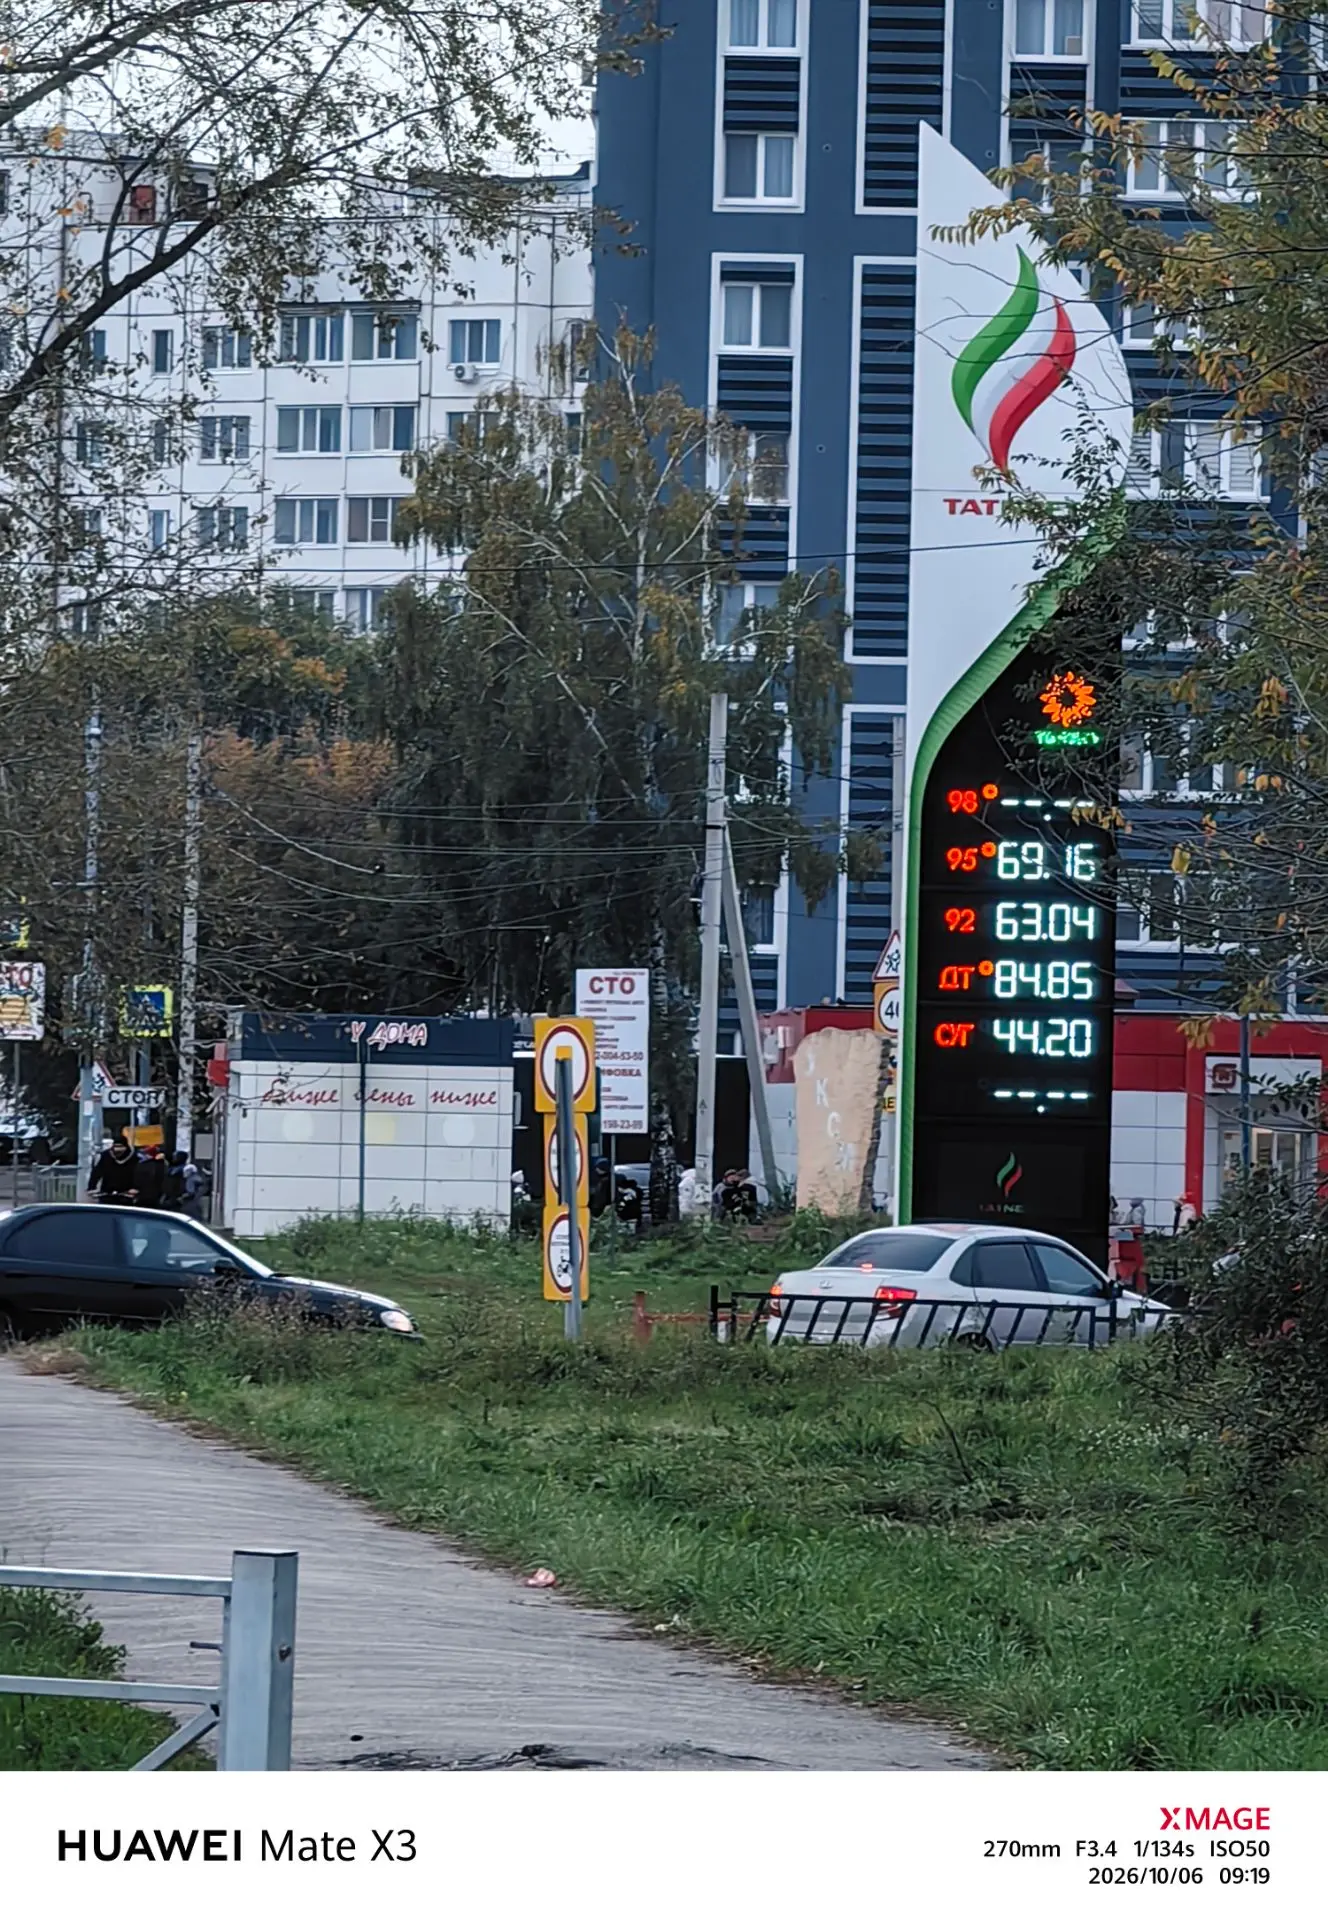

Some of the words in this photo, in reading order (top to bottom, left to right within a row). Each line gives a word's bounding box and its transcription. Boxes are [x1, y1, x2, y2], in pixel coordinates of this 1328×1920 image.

[947, 790, 979, 814] 98
[946, 848, 978, 872] 95
[997, 841, 1096, 881] 69.16
[944, 908, 976, 933] 92
[995, 902, 1095, 942] 63.04
[589, 976, 636, 995] СТО
[938, 965, 975, 990] ДТ
[994, 960, 1093, 999] 84.85
[351, 1020, 367, 1043] У
[366, 1021, 428, 1051] ДОМА
[934, 1022, 975, 1047] СУГ
[993, 1018, 1092, 1057] 44.20
[430, 1090, 497, 1107] ниже
